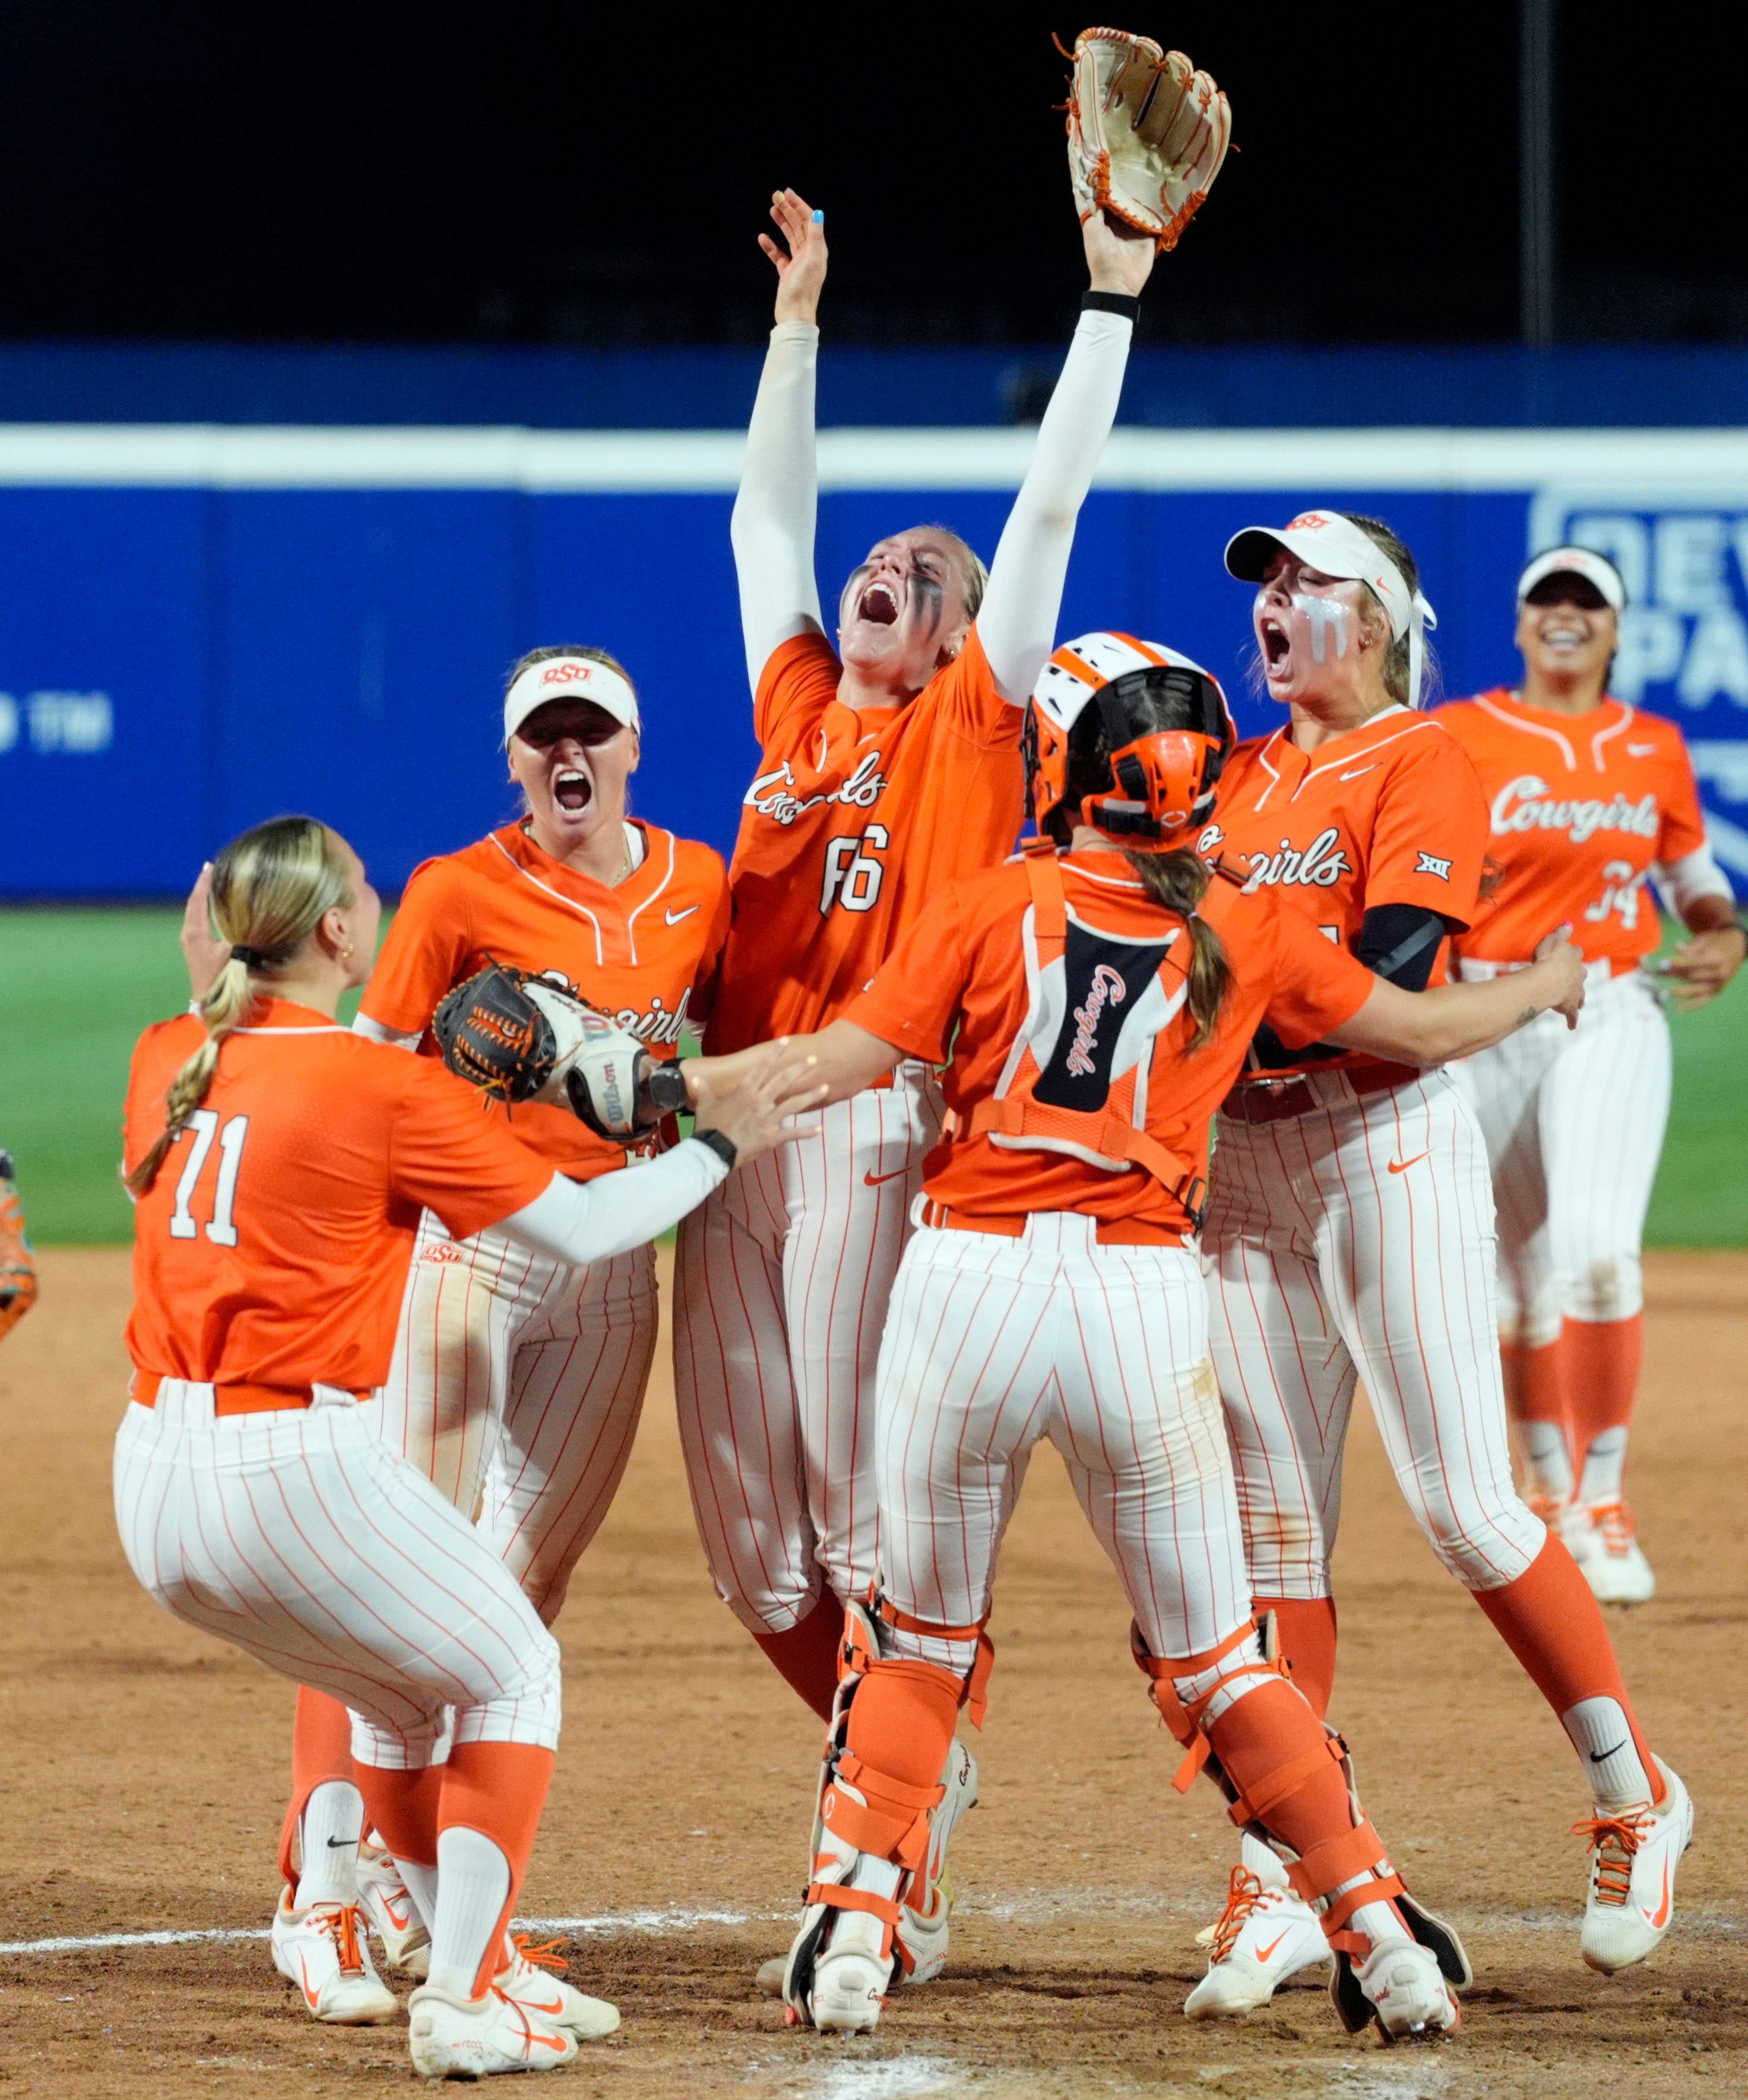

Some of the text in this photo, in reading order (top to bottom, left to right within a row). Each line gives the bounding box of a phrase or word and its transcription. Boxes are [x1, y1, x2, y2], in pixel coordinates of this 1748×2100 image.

[1490, 774, 1659, 843] Cowgirls
[1066, 964, 1126, 1078] Cowgirls
[170, 1107, 249, 1248] 71
